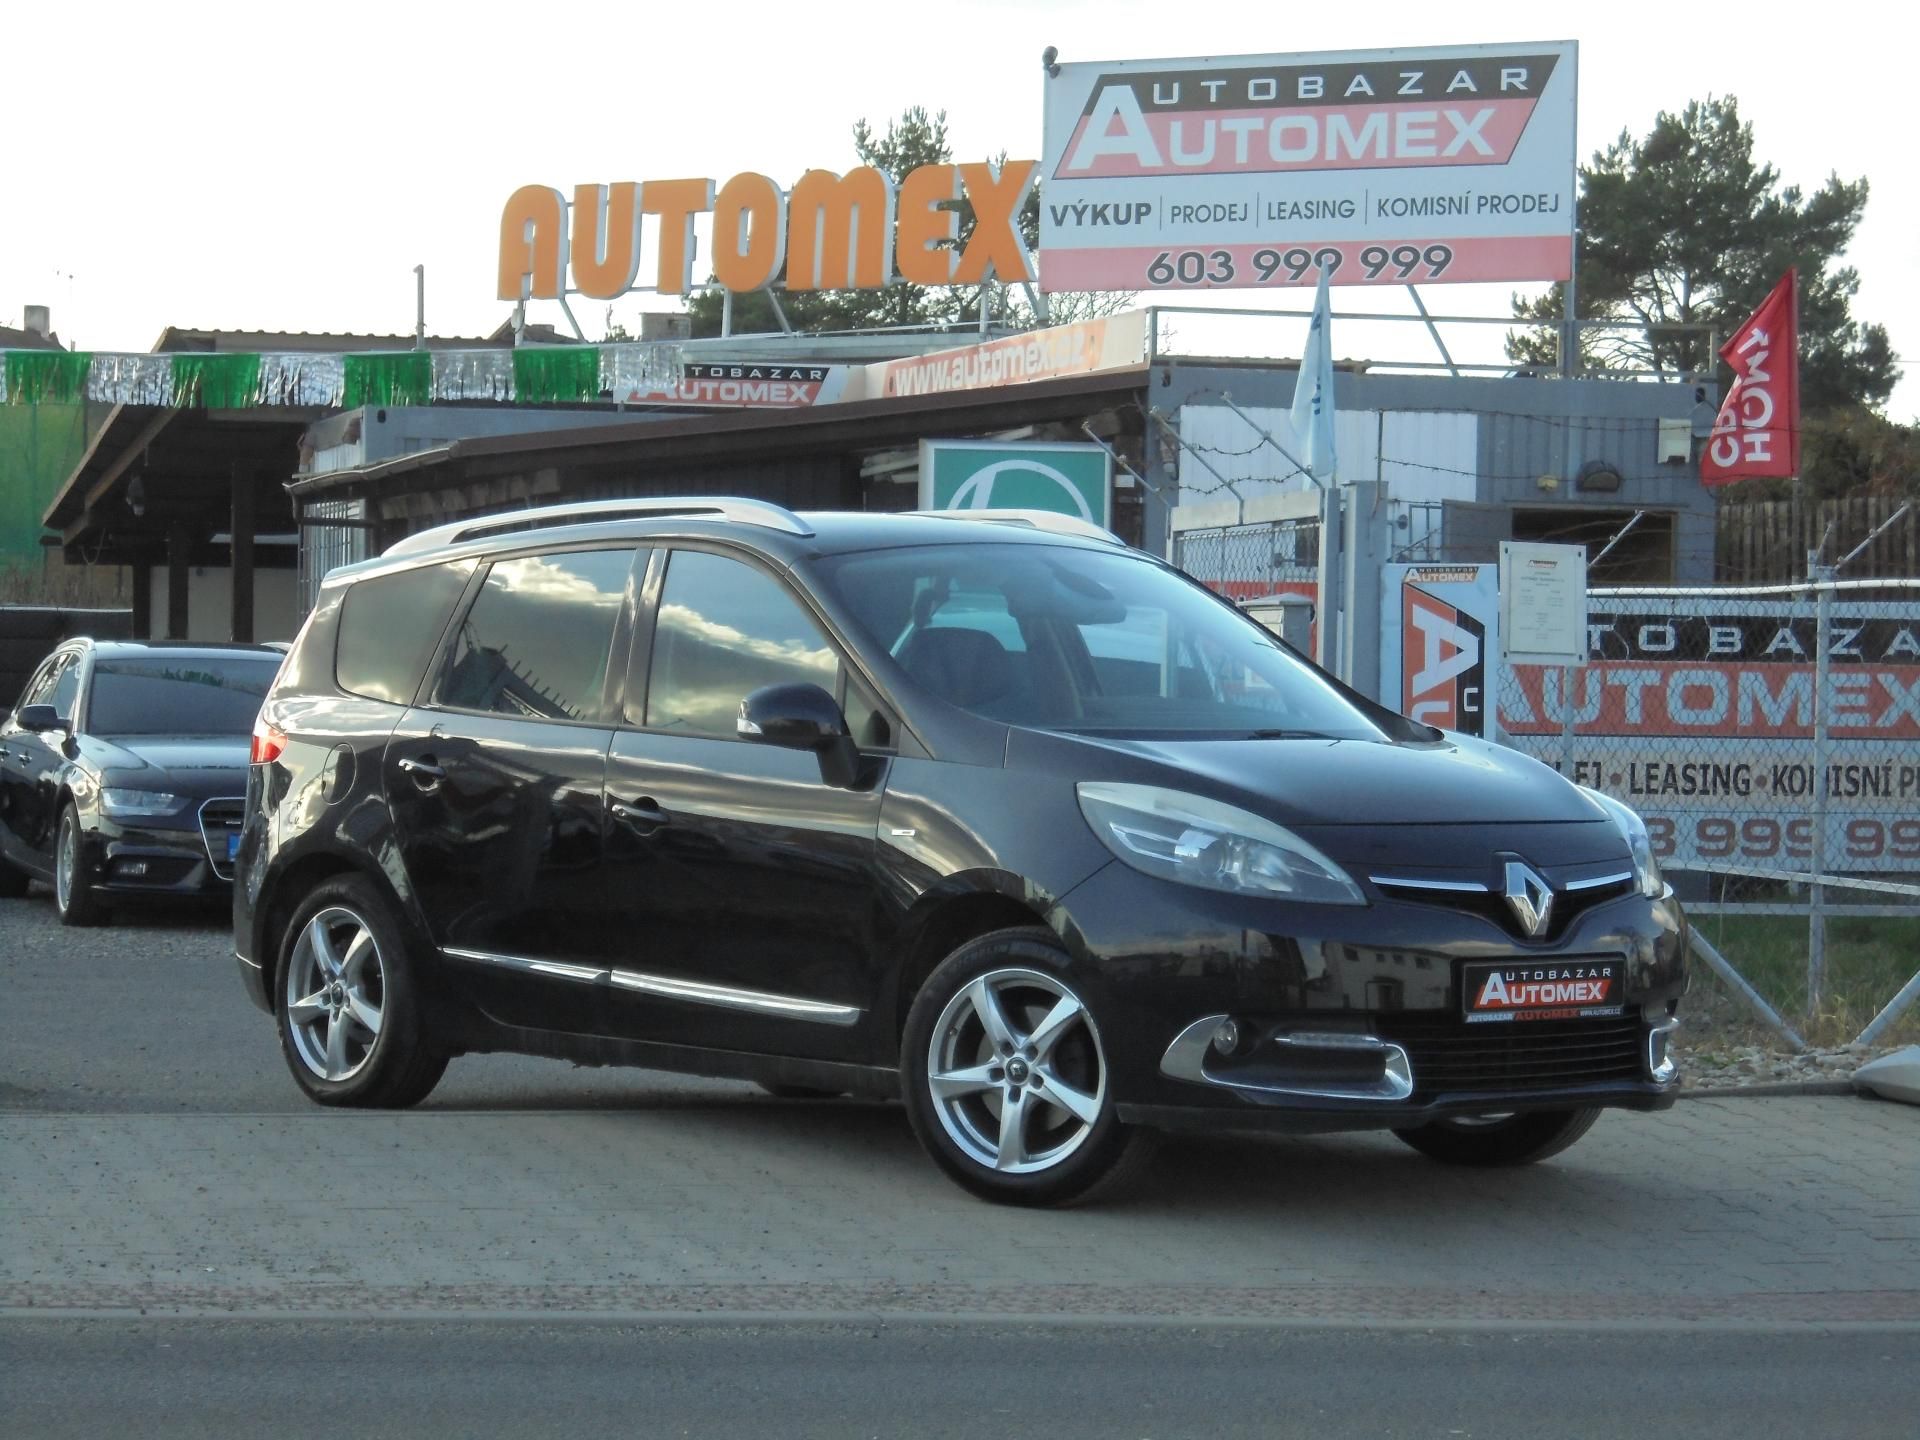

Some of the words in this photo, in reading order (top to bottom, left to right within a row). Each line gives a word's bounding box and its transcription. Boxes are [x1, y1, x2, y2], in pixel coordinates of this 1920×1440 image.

[1067, 84, 1495, 169] AUTOMEX
[1050, 199, 1152, 227] VÝKUP
[1170, 202, 1248, 224] PRODEJ
[1267, 199, 1355, 221] LEASING
[1377, 190, 1472, 217] KOMISNÍ
[1477, 193, 1560, 214] PRODEJ
[497, 160, 1041, 300] AUTOMEX
[1147, 250, 1235, 285] 603
[1252, 247, 1343, 282] 999
[1360, 244, 1453, 279] 999
[1406, 568, 1473, 582] AUTOMEX
[1630, 761, 1751, 797] LEASING
[1479, 972, 1603, 1006] AUTOMEX
[1515, 1007, 1578, 1021] AUTOMEX
